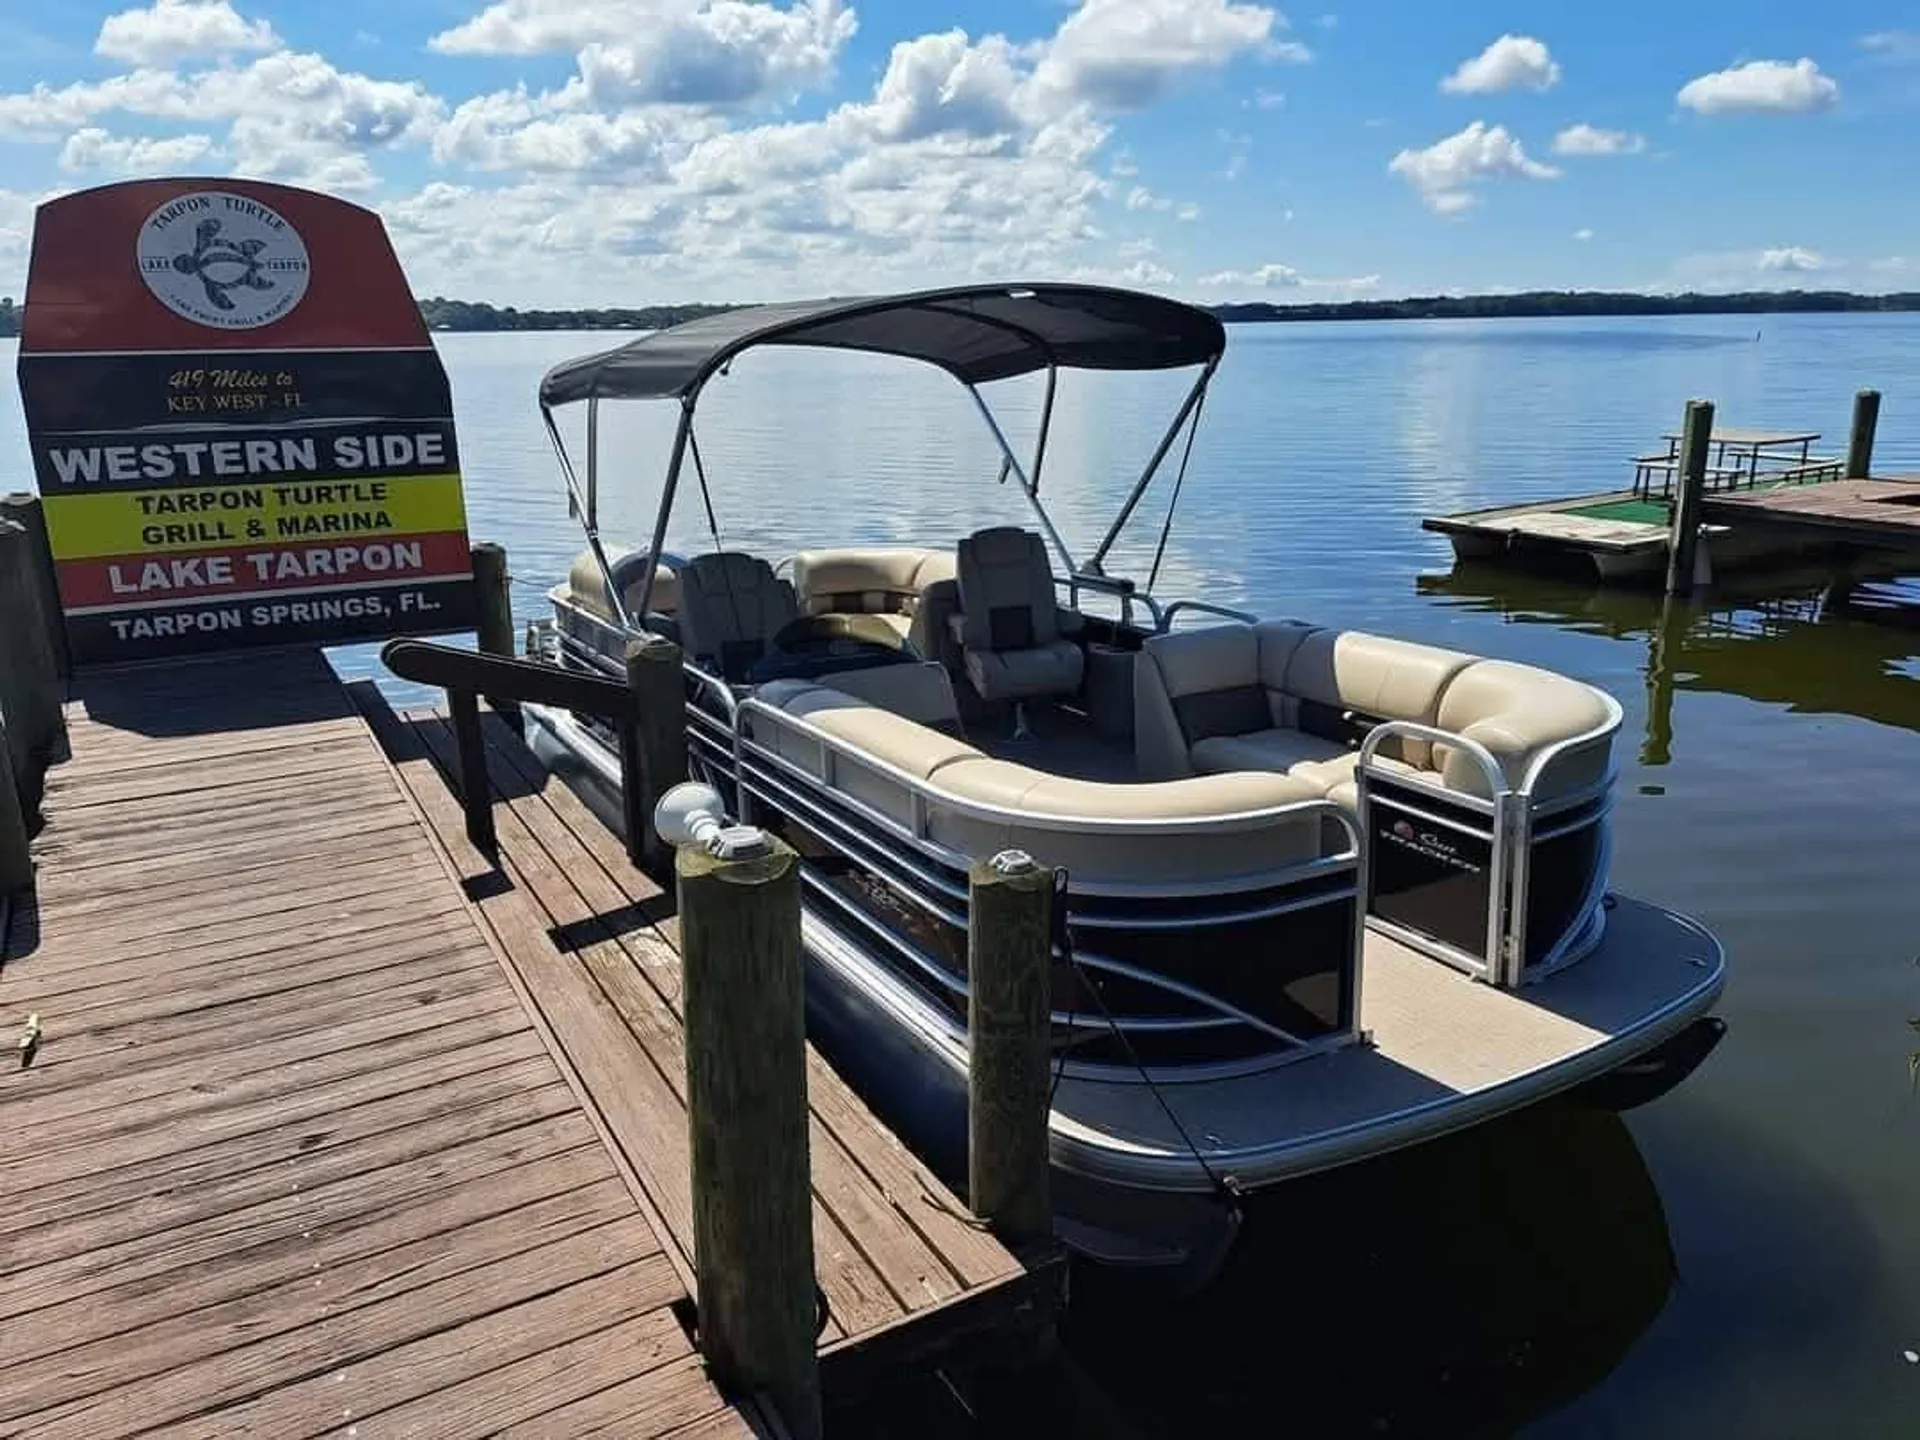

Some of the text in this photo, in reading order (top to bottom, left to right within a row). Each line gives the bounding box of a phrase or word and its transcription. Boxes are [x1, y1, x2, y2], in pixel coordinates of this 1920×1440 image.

[152, 197, 286, 231] TARPON TURTLE
[168, 370, 293, 388] 419 Miles to
[167, 396, 207, 412] KEY
[213, 394, 269, 410] WEST
[49, 434, 445, 483] WESTERN SIDE
[136, 483, 387, 515] TARPON TURTLE
[142, 512, 392, 545] GRILL & MARINA
[109, 543, 422, 593] LAKE TARPON
[110, 592, 440, 641] TARPON SPRINGS, FL.
